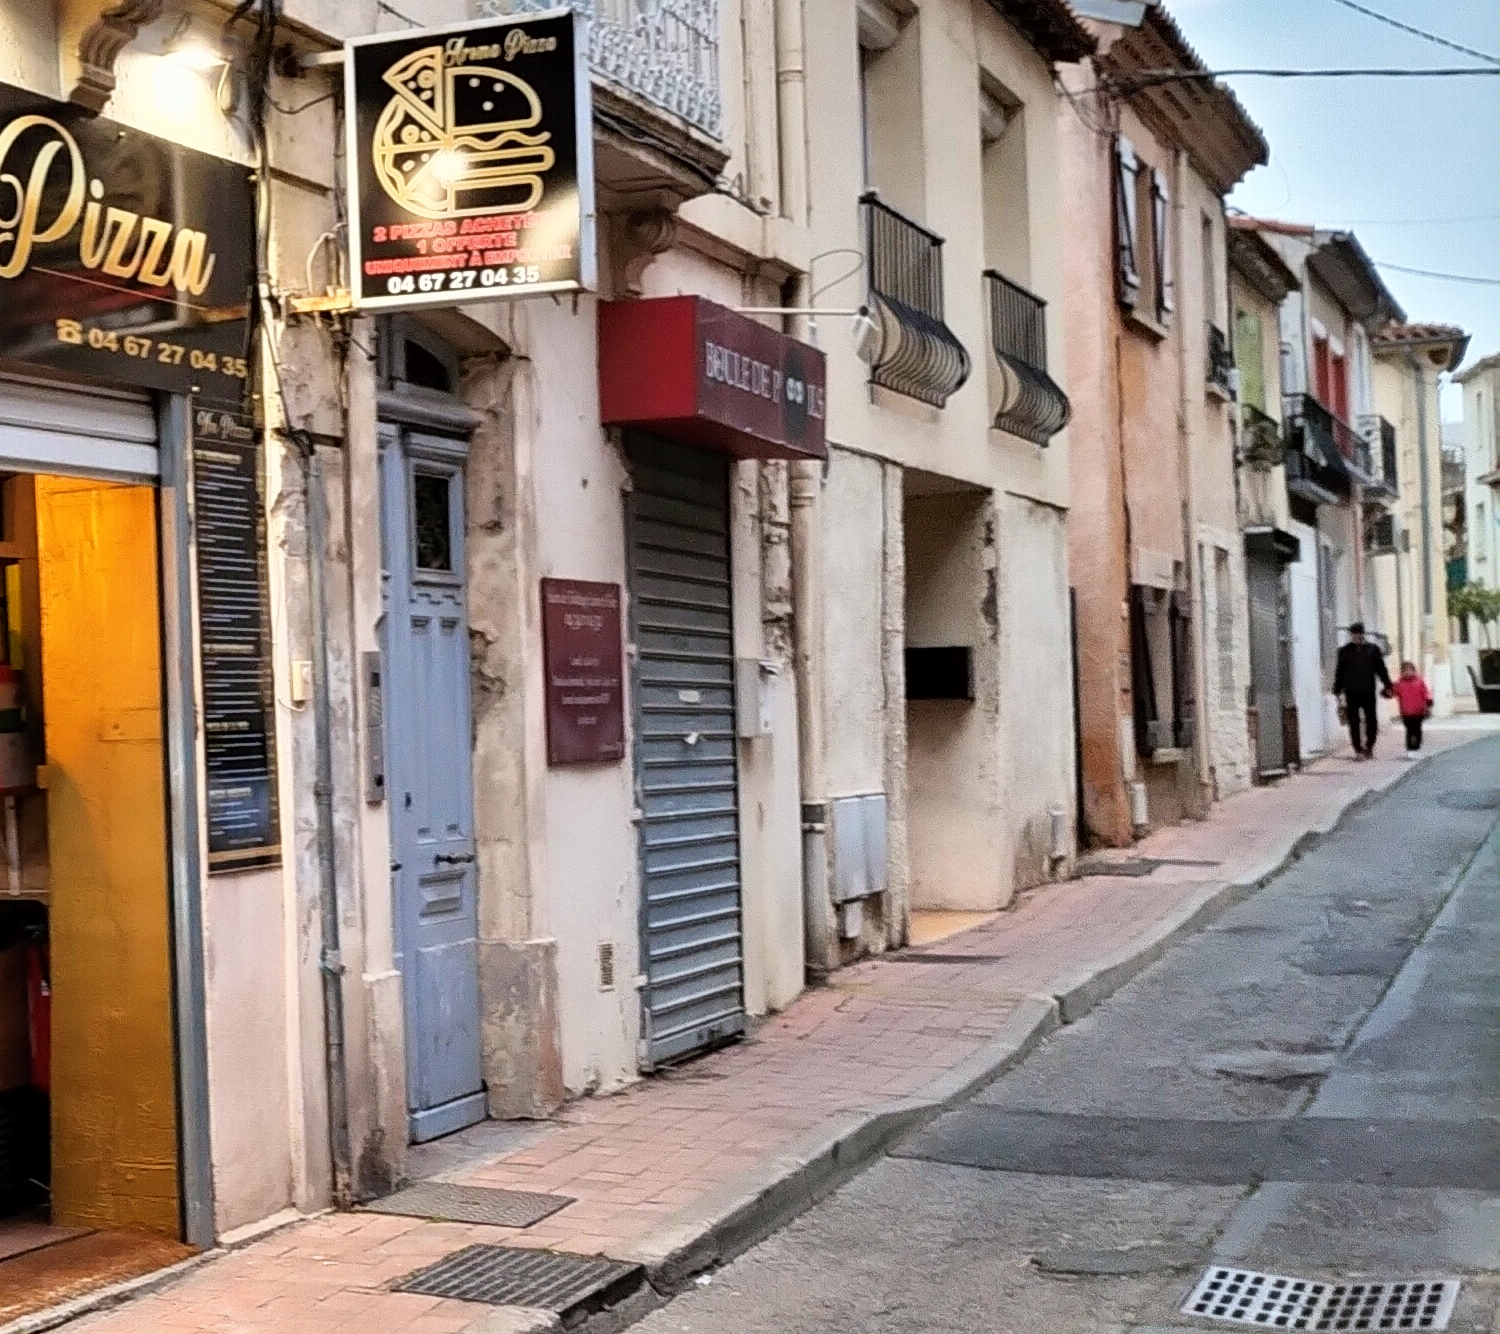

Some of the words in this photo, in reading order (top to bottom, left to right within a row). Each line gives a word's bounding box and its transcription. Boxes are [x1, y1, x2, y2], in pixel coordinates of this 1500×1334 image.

[443, 36, 501, 67] Aroma
[504, 28, 557, 62] Pizza
[373, 226, 388, 243] 2
[417, 239, 427, 255] 1
[484, 244, 572, 265] EMPOER
[387, 274, 415, 295] 04
[418, 272, 446, 292] 67
[449, 270, 477, 290] 27
[480, 268, 509, 287] 04
[512, 265, 540, 284] 35
[88, 327, 120, 353] 04
[123, 335, 153, 359] 67
[157, 342, 185, 366] 27
[190, 349, 217, 372] 04
[221, 355, 249, 379] 35
